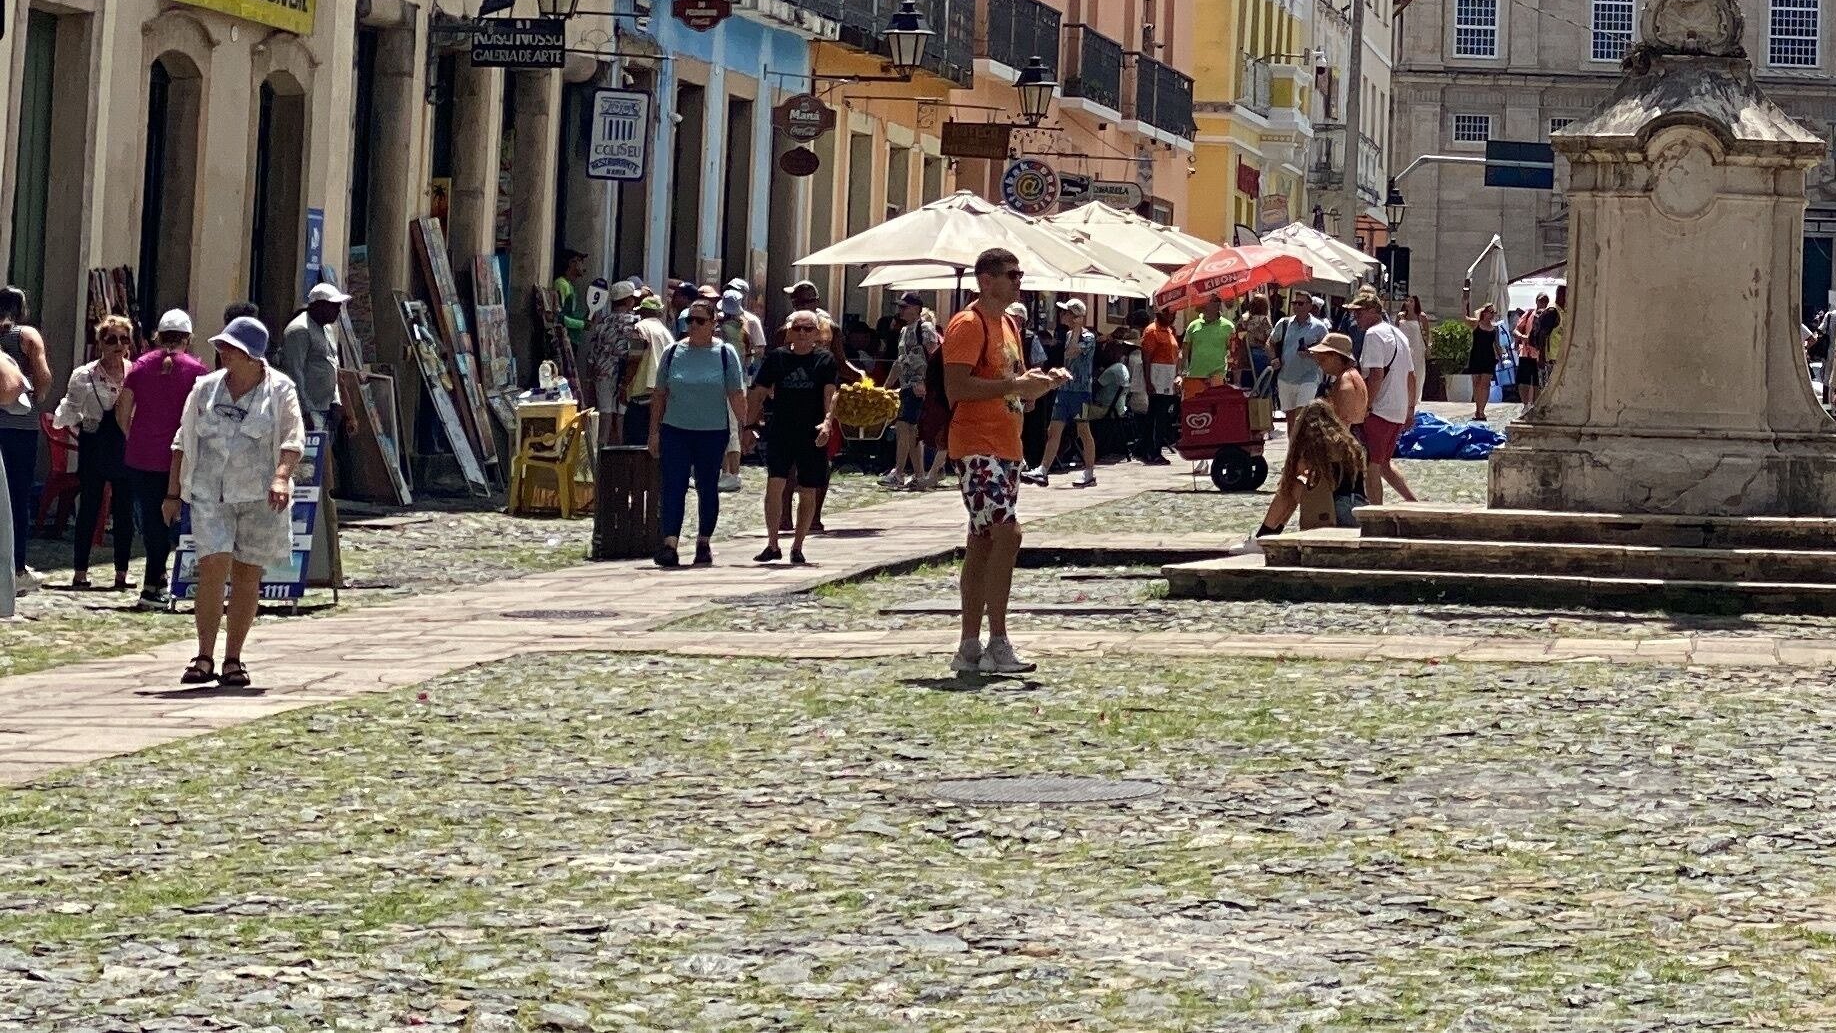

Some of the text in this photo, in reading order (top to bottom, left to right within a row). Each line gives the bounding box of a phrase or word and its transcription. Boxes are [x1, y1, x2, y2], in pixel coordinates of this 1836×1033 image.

[519, 50, 532, 62] DE
[532, 49, 563, 63] ARTE
[789, 109, 820, 121] Maná
[1203, 273, 1238, 290] KIBON
[592, 291, 601, 305] 9
